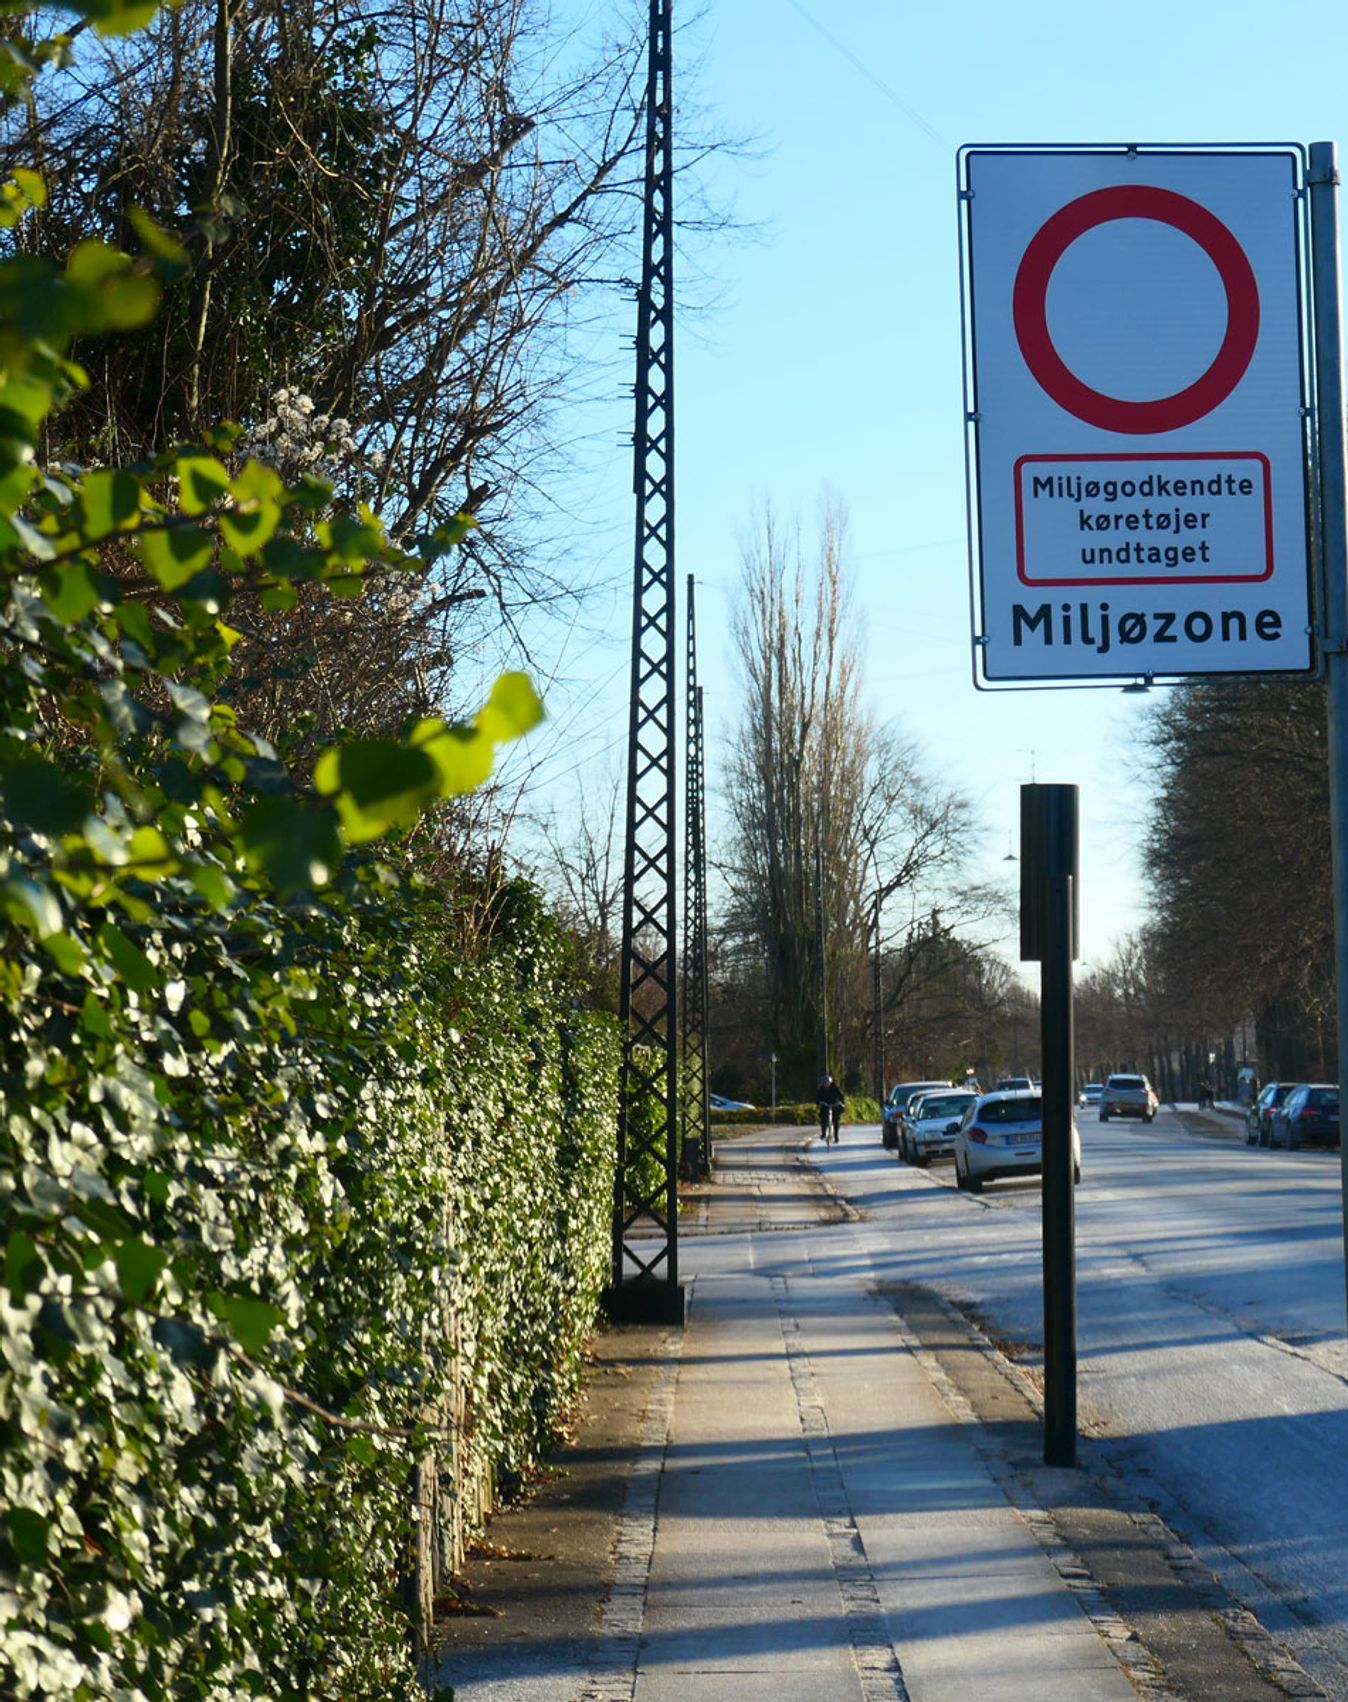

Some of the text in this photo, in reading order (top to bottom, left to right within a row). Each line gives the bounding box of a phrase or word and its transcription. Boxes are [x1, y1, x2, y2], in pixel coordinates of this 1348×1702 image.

[1032, 474, 1254, 503] Miljøgodkendte
[1079, 508, 1211, 534] køretøjer
[1081, 541, 1211, 568] undtaget
[1012, 602, 1283, 654] Miljøzone
